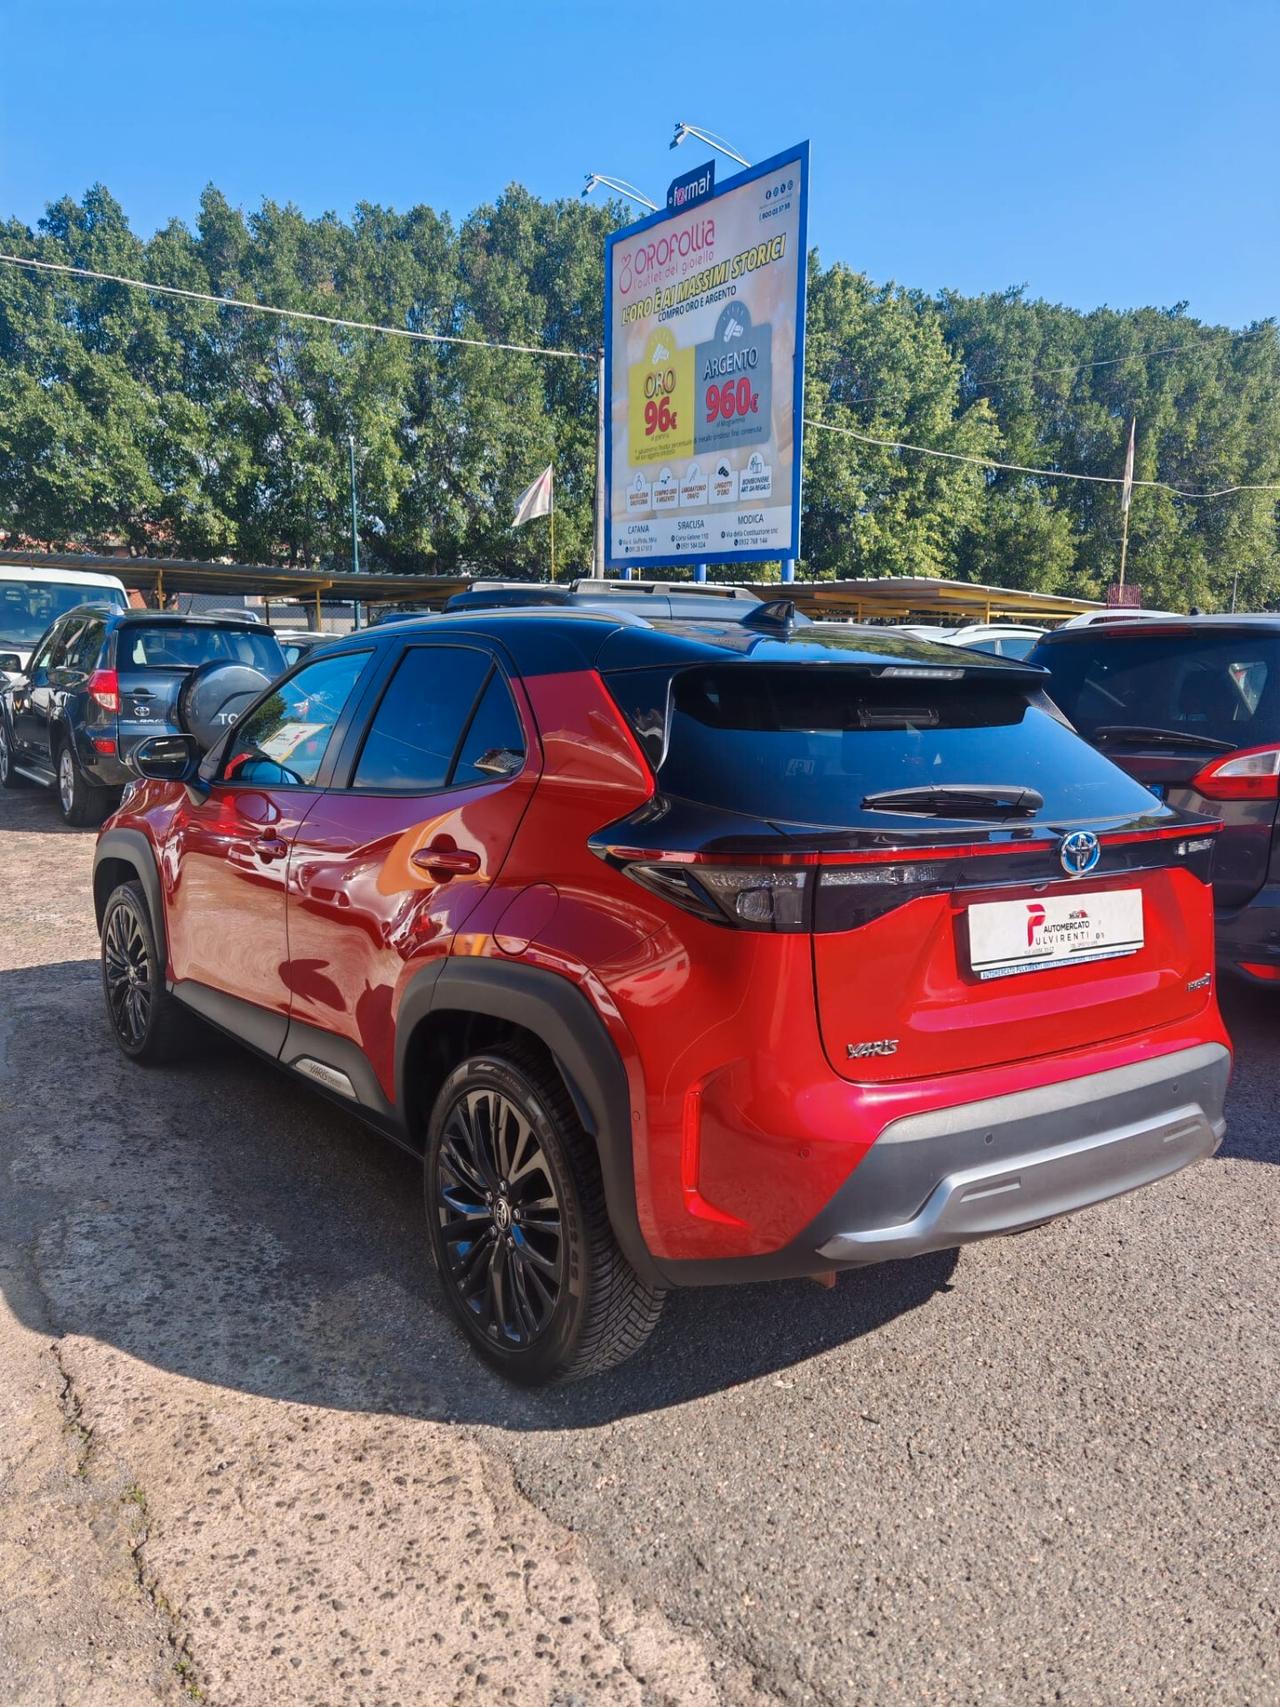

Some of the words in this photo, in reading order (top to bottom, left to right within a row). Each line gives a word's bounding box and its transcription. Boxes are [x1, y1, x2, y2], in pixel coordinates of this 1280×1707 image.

[621, 296, 653, 327] L'ORO
[653, 287, 662, 314] È
[661, 284, 676, 310] AI
[675, 259, 730, 304] MASSIMI
[731, 232, 786, 279] STORICI
[657, 305, 685, 322] COMPRO
[685, 299, 699, 313] ORO
[700, 297, 704, 307] E
[704, 285, 737, 305] ARGENTO
[703, 346, 759, 381] ARGENTO
[643, 368, 676, 399] ORO
[705, 377, 759, 423] 960€
[644, 396, 677, 436] 96€
[677, 519, 705, 531] SIRACUSA
[737, 514, 764, 525] MODICA
[1043, 920, 1090, 934] AUTOMERCATO
